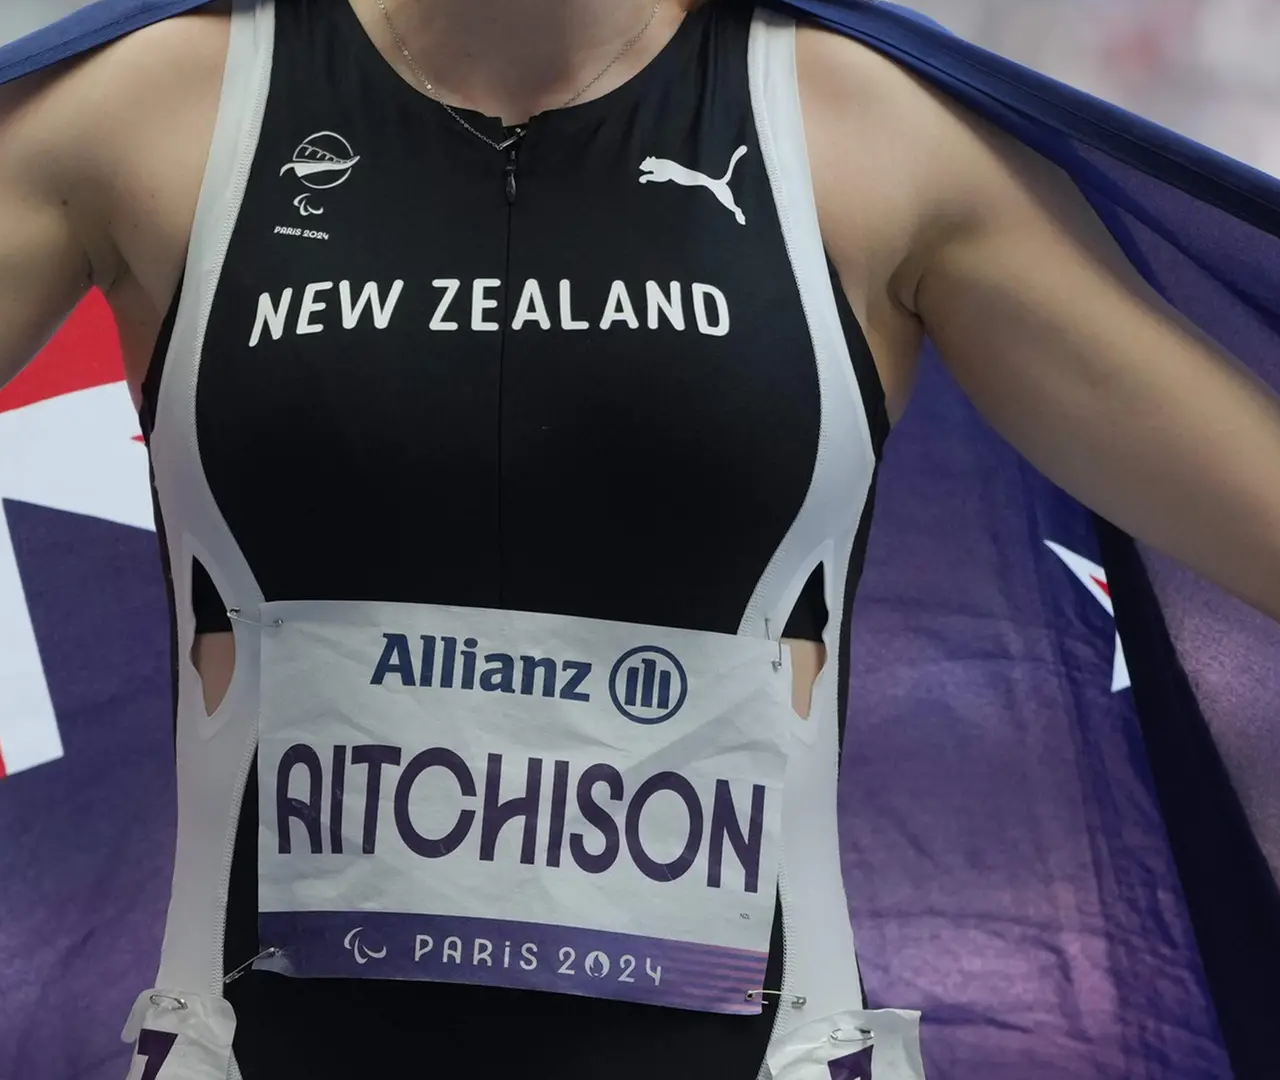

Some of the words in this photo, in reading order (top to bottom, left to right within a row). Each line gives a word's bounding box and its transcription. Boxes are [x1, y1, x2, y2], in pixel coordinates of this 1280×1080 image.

[302, 229, 329, 240] 2024
[248, 278, 405, 347] NEW
[428, 278, 730, 337] ZEALAND
[369, 632, 593, 703] Allianz
[275, 743, 766, 894] AITCHISON
[557, 946, 663, 987] 2024
